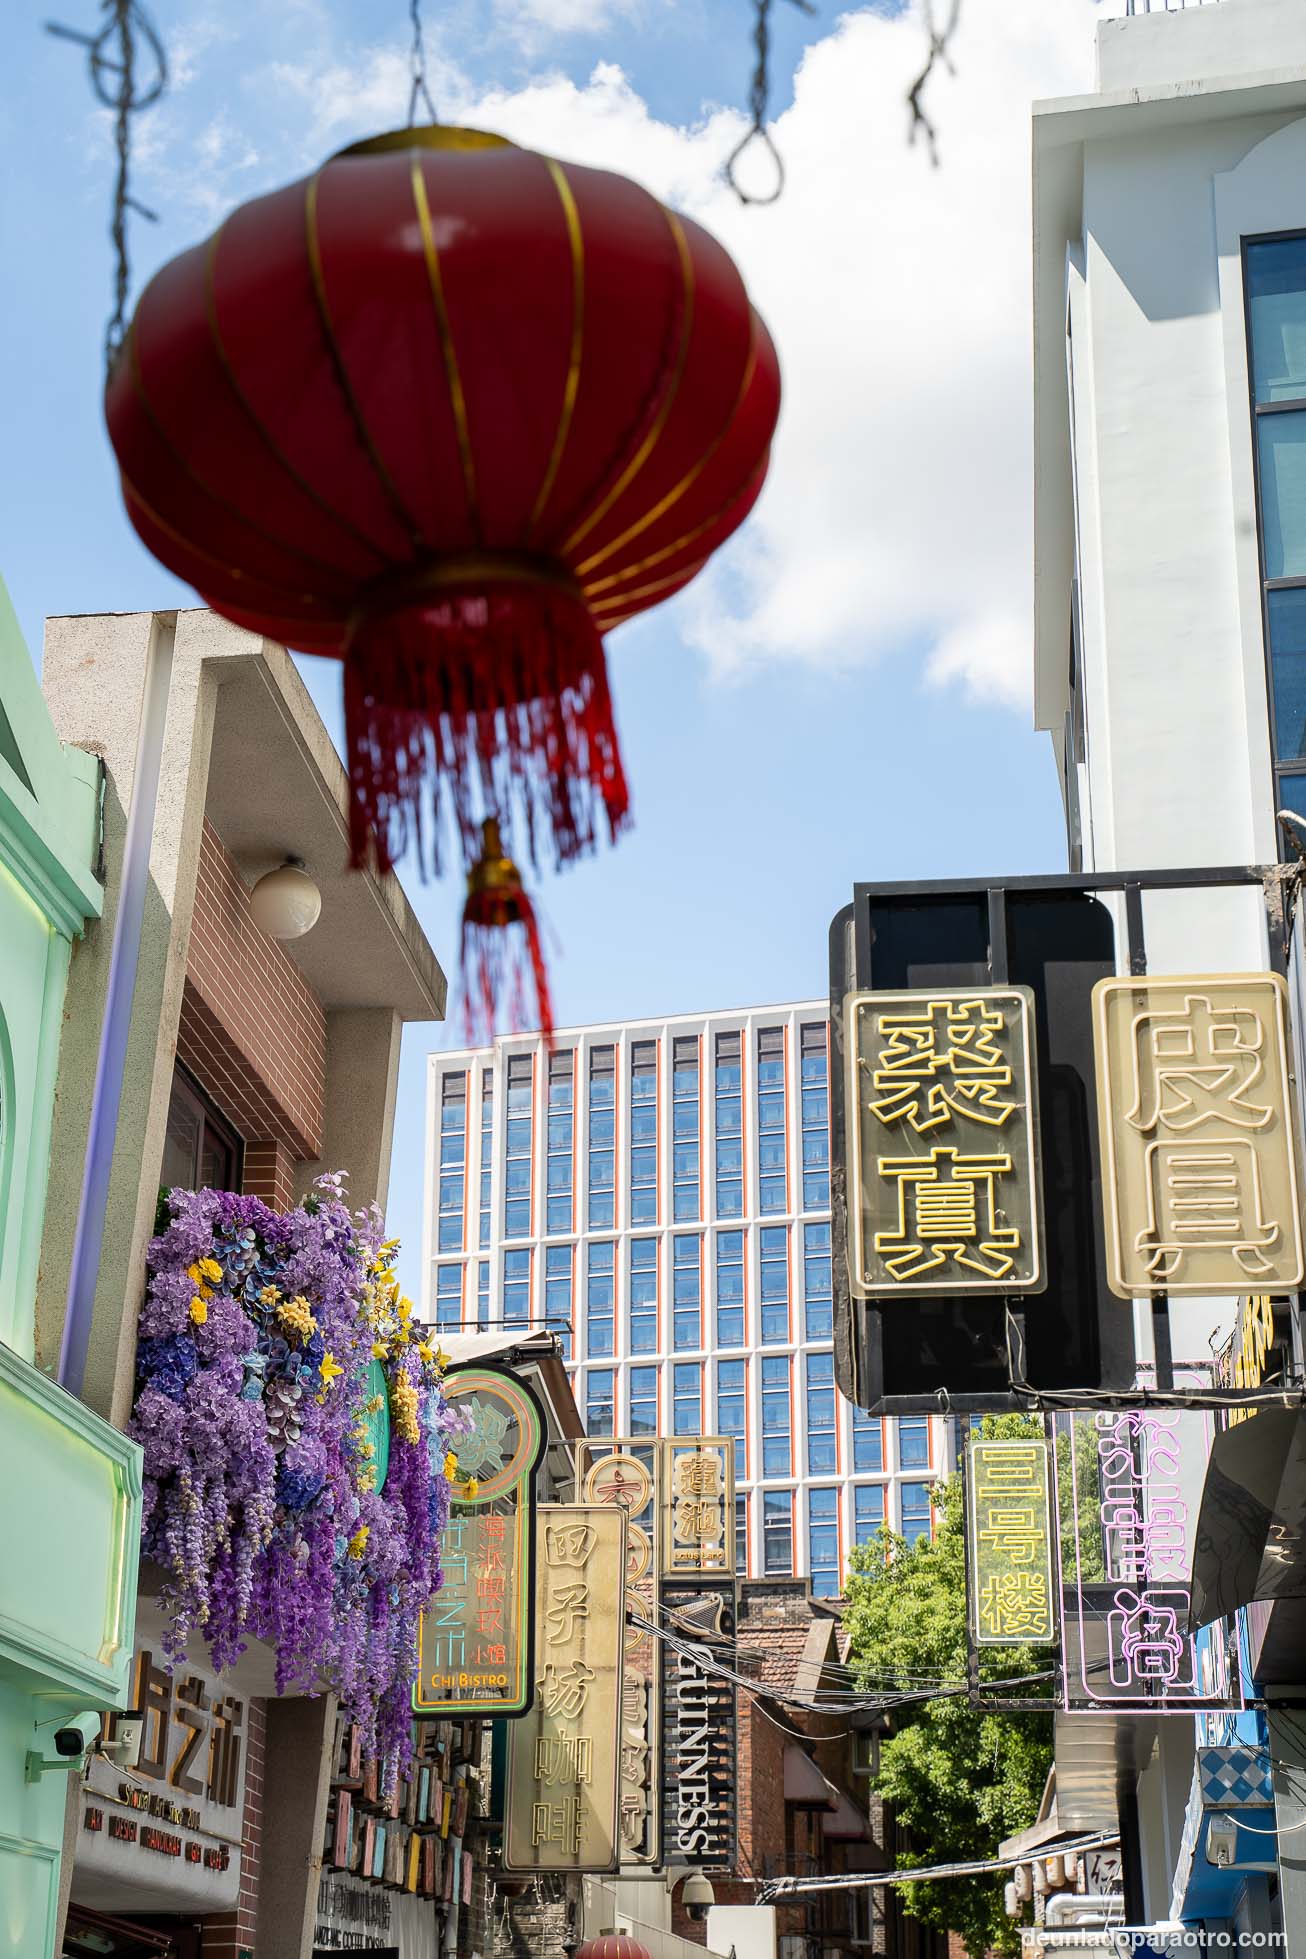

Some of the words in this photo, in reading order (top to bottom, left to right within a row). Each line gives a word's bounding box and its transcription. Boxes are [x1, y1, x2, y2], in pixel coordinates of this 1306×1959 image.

[978, 1448, 1048, 1636] 三号楼
[676, 1644, 713, 1853] GUINNESS
